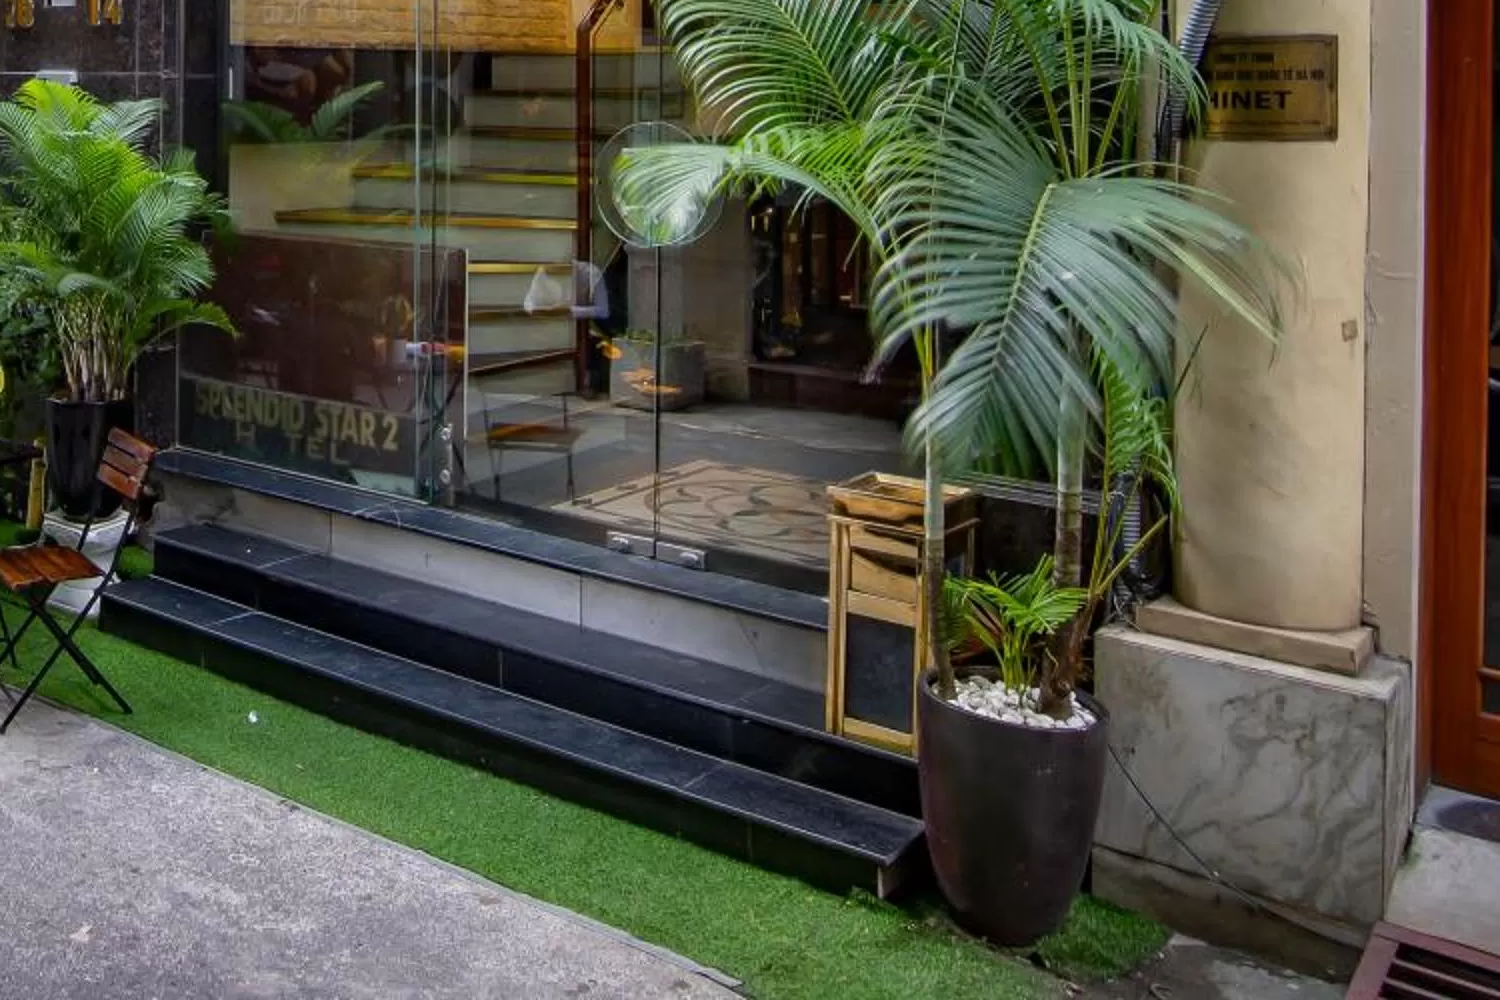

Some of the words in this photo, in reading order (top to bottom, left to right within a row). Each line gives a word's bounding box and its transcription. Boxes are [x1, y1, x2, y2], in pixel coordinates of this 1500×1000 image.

[195, 382, 305, 431] SPLENDID
[315, 403, 376, 449] STAR
[383, 416, 399, 452] 2
[235, 420, 352, 467] HTEL
